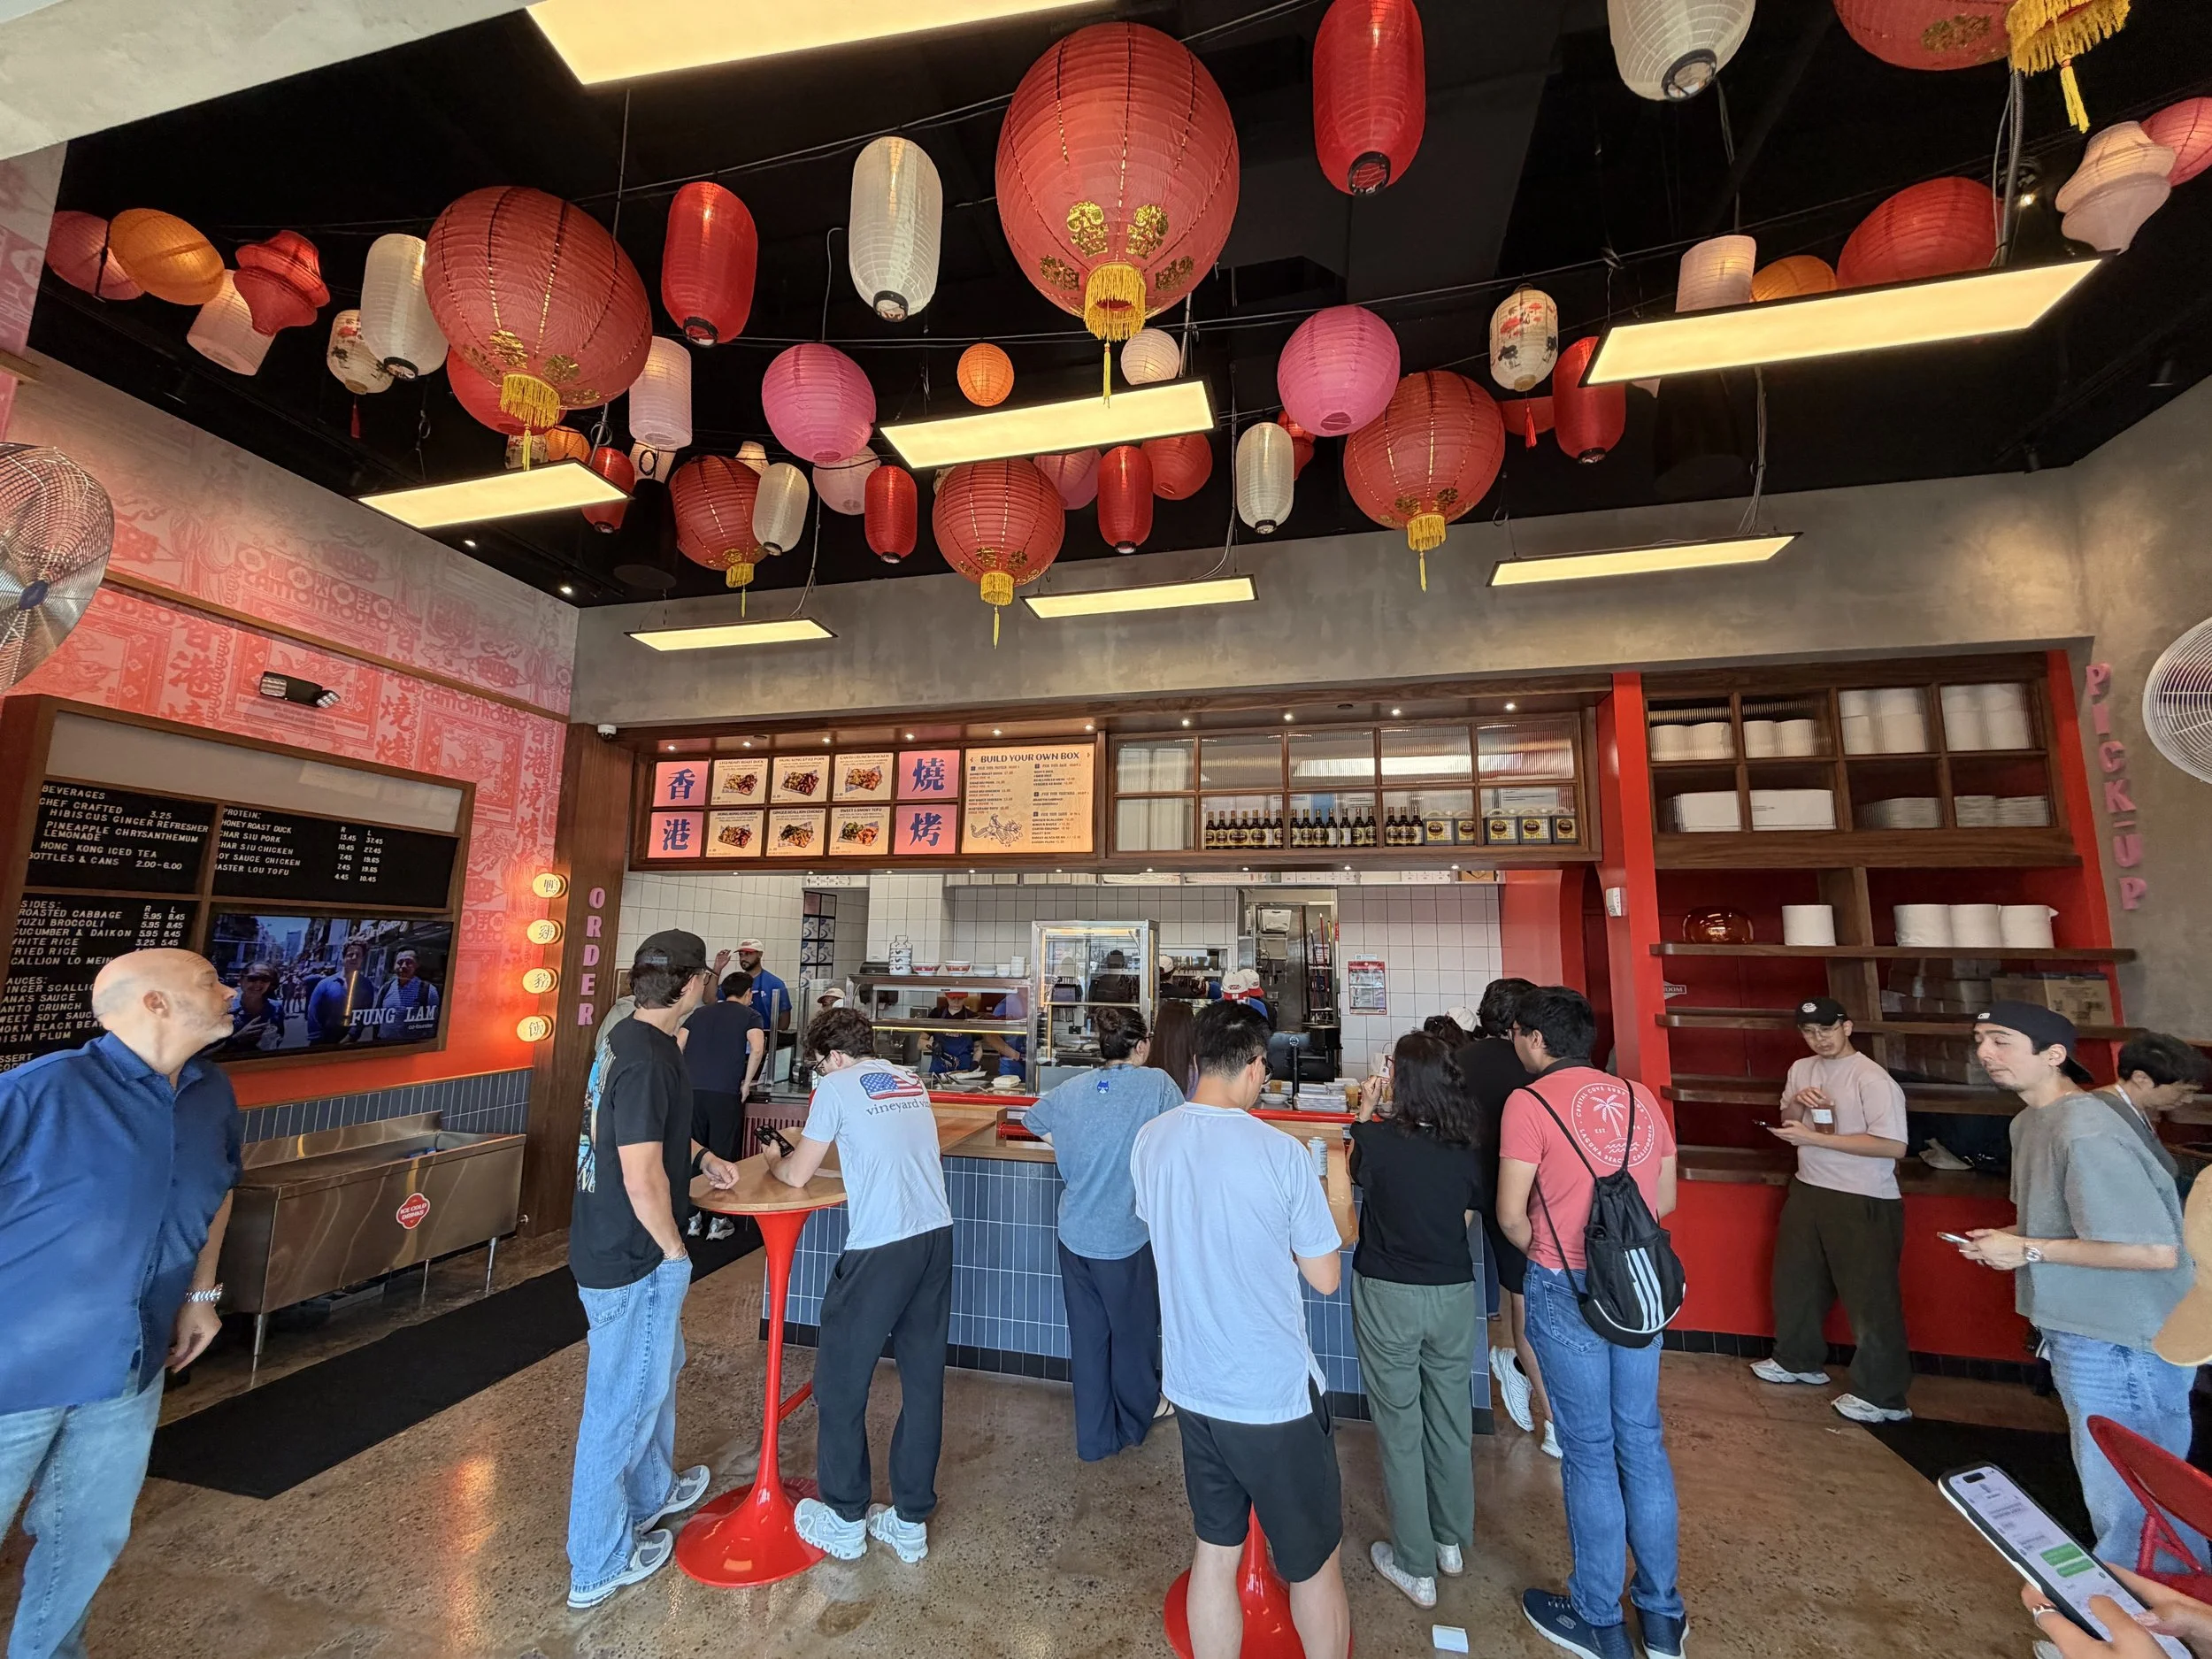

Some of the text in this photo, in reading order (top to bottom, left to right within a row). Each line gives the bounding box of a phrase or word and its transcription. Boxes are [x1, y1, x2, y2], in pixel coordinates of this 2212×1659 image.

[912, 757, 945, 792] 燒
[42, 785, 105, 799] BEVERAGES
[667, 769, 695, 800] 香
[39, 797, 172, 819] CHEF CRAFTED 3.25
[223, 809, 261, 819] PROTEIN:
[50, 809, 209, 833] HIBISCUS GINGER REFRESHER
[222, 819, 246, 828] HONEY
[910, 812, 941, 846] 烤
[43, 829, 102, 841] LEMONADE
[46, 821, 198, 842] PINEAPPLE CHRYSANTHEMUM
[663, 819, 690, 850] 港
[40, 841, 69, 850] HONG
[138, 849, 157, 858] TEA
[258, 846, 294, 855] CHICKEN
[28, 852, 74, 862] BOTTLES
[90, 856, 119, 865] CANS
[234, 854, 260, 863] SAUCE
[265, 857, 301, 866] CHICKEN
[577, 887, 607, 1026] ORDER
[349, 1005, 437, 1026] FUNG LAM
[34, 1023, 73, 1032] BLACK
[39, 1032, 72, 1041] PLUM
[866, 1099, 918, 1116] vineyard
[1577, 1093, 1587, 1118] CRYSTAL
[1579, 1129, 1601, 1156] LAGUNA
[1632, 1125, 1651, 1161] CALIFORNIA
[402, 1210, 425, 1220] DRINKS
[411, 1202, 426, 1211] COLD
